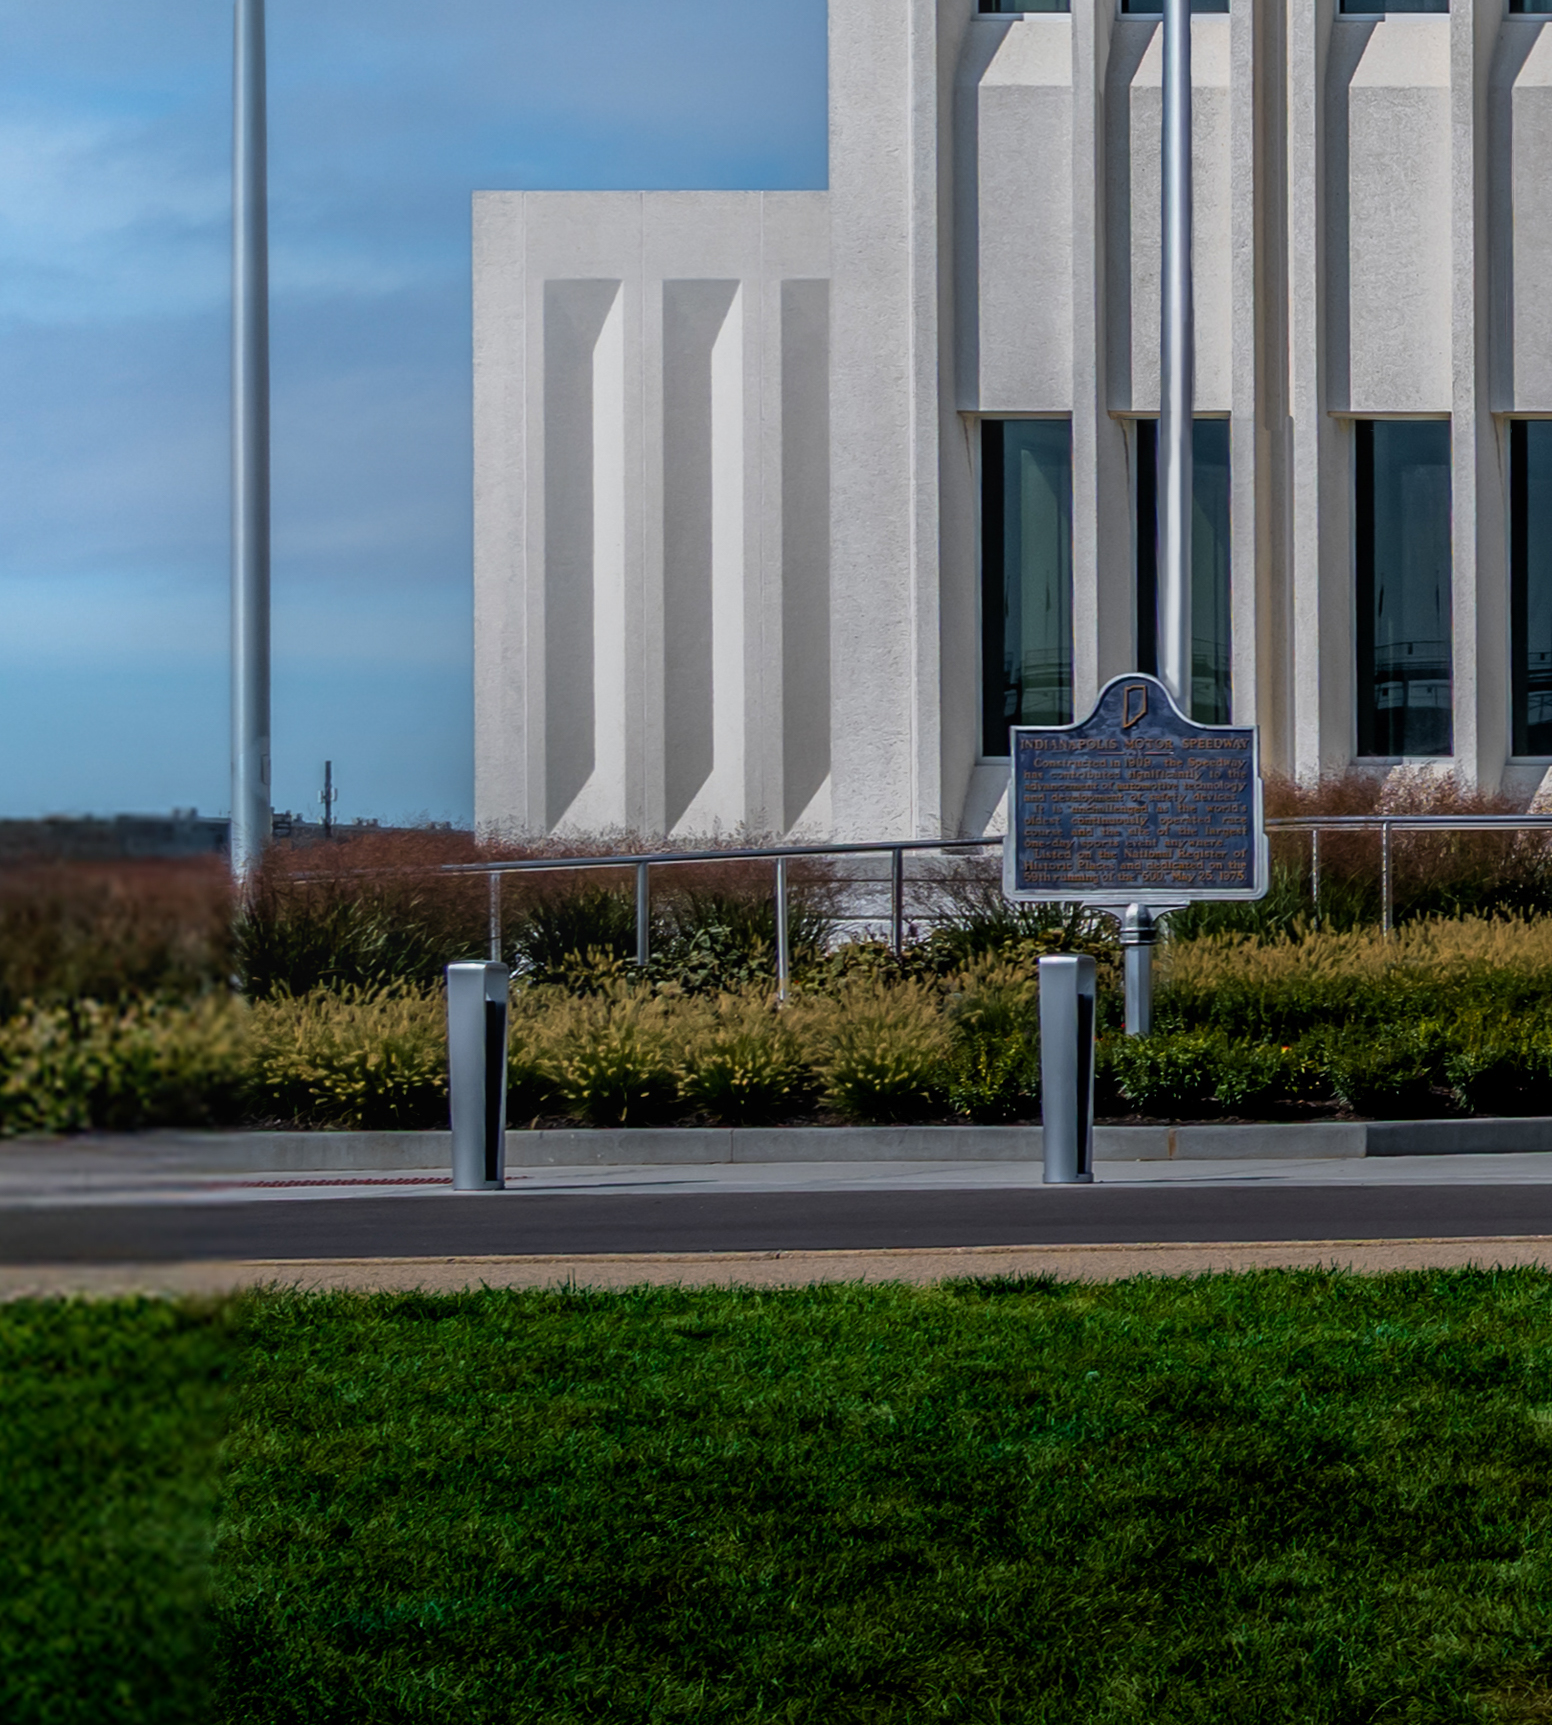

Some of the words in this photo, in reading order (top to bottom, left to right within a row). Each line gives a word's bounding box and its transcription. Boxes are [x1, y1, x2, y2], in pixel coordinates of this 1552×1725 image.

[1020, 738, 1118, 751] INDIANAPOLIS
[1125, 738, 1175, 750] MOTOR
[1182, 738, 1250, 750] SPEEDWAY
[1033, 758, 1107, 768] Constructed
[1110, 758, 1121, 768] in
[1164, 758, 1183, 768] the
[1188, 757, 1247, 770] Speedway
[1024, 770, 1043, 779] has
[1050, 770, 1121, 779] contributed
[1128, 769, 1202, 781] significantly
[1209, 769, 1221, 779] to
[1228, 769, 1247, 779] the
[1024, 782, 1099, 790] advancement
[1102, 782, 1114, 790] of
[1117, 782, 1178, 791] automotive
[1183, 781, 1247, 792] technology
[1024, 793, 1045, 802] and
[1051, 793, 1124, 804] development
[1130, 793, 1143, 802] of
[1149, 793, 1188, 803] safety
[1034, 805, 1044, 813] It
[1052, 805, 1063, 813] is
[1071, 805, 1149, 815] unchallenged
[1156, 805, 1169, 813] as
[1177, 804, 1197, 813] the
[1206, 804, 1247, 813] world's
[1024, 817, 1062, 825] oldest
[1071, 816, 1149, 826] continuously
[1160, 816, 1212, 827] operated
[1222, 817, 1247, 825] race
[1024, 828, 1063, 836] course
[1071, 828, 1094, 836] and
[1102, 828, 1121, 836] the
[1128, 827, 1150, 836] site
[1157, 827, 1170, 836] of
[1178, 827, 1198, 836] the
[1205, 827, 1248, 838] largest
[1024, 839, 1076, 850] one-day
[1081, 839, 1120, 849] sports
[1126, 838, 1158, 848] event
[1034, 849, 1072, 859] Listed
[1078, 850, 1092, 859] on
[1098, 849, 1118, 859] the
[1124, 849, 1173, 859] National
[1179, 849, 1227, 861] Register
[1233, 849, 1247, 858] of
[1024, 861, 1073, 871] Historic
[1078, 860, 1116, 871] Places
[1121, 860, 1142, 870] and
[1147, 860, 1205, 870] dedicated
[1209, 861, 1223, 870] on
[1228, 860, 1247, 870] the
[1024, 871, 1051, 882] 59th
[1052, 872, 1100, 883] running
[1102, 872, 1114, 881] of
[1117, 872, 1134, 881] the
[1172, 871, 1197, 883] May
